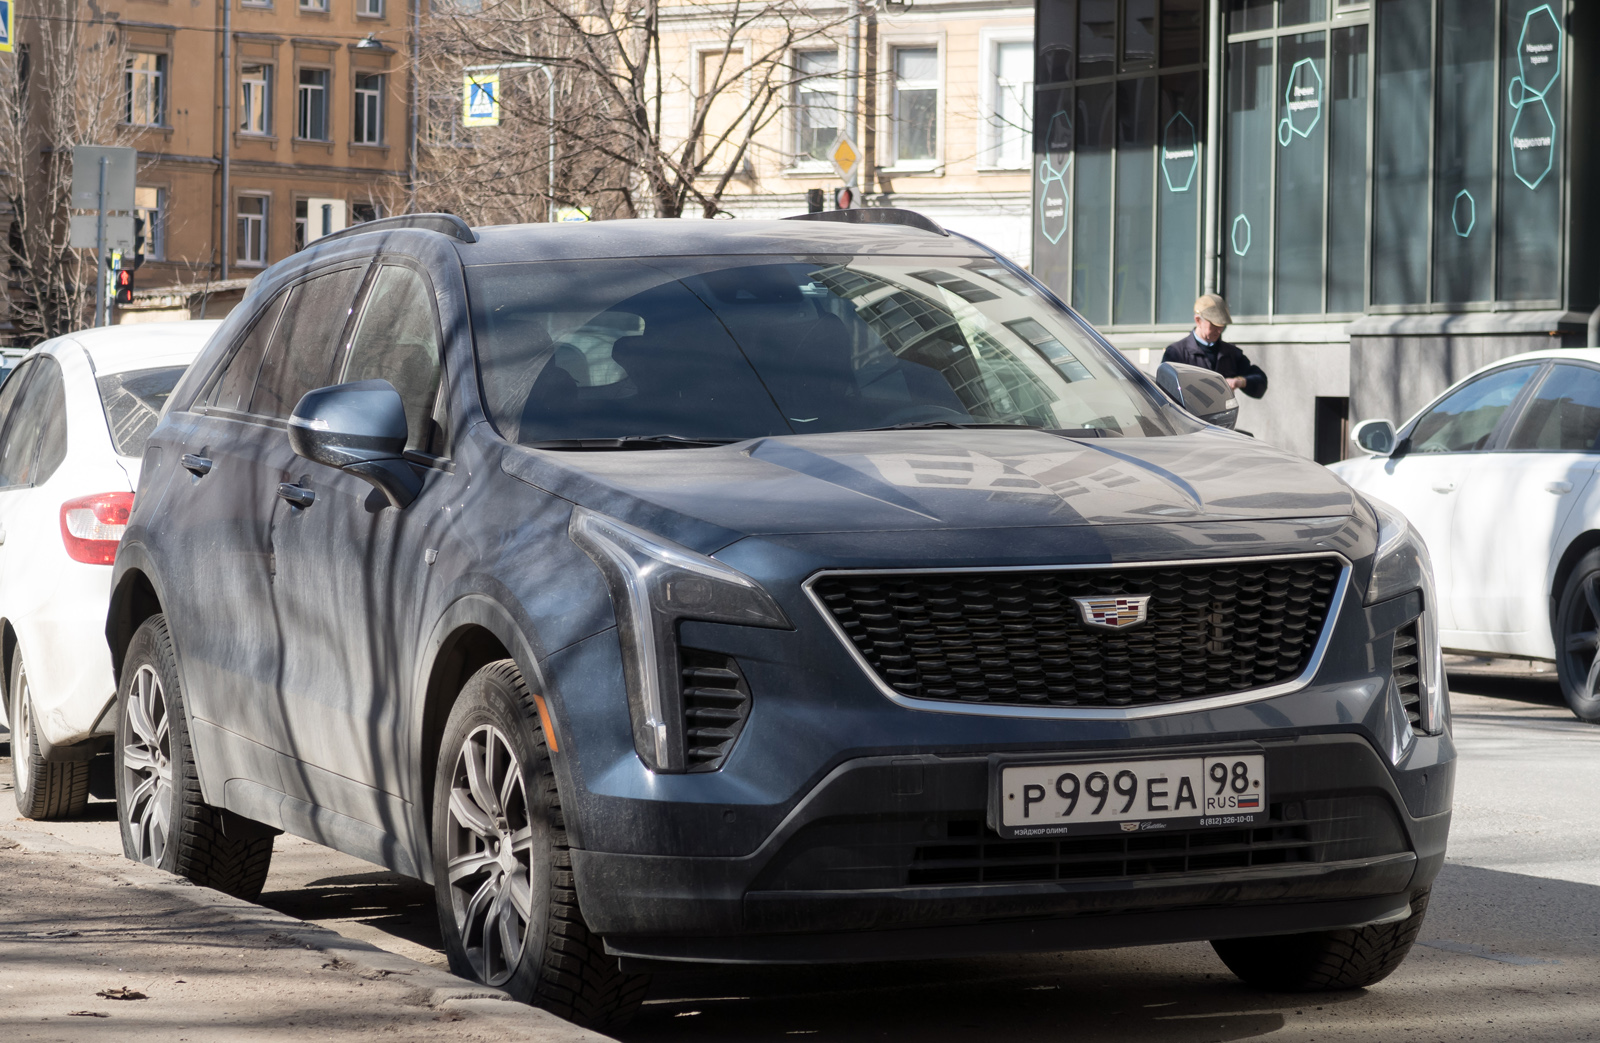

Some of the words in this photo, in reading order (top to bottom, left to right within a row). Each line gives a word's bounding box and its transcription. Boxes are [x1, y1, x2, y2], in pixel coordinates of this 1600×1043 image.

[1513, 136, 1551, 150] Кардиология
[1210, 761, 1249, 796] 98
[1023, 769, 1197, 818] Р999ЕА
[1207, 796, 1236, 809] RUS
[1140, 821, 1167, 831] Cadillac
[1199, 818, 1205, 826] 8
[1205, 817, 1222, 826] (812)
[1223, 815, 1254, 824] 326-10-01
[1014, 828, 1045, 836] МЭЙДЖОР
[1046, 827, 1068, 835] ОЛИМП
